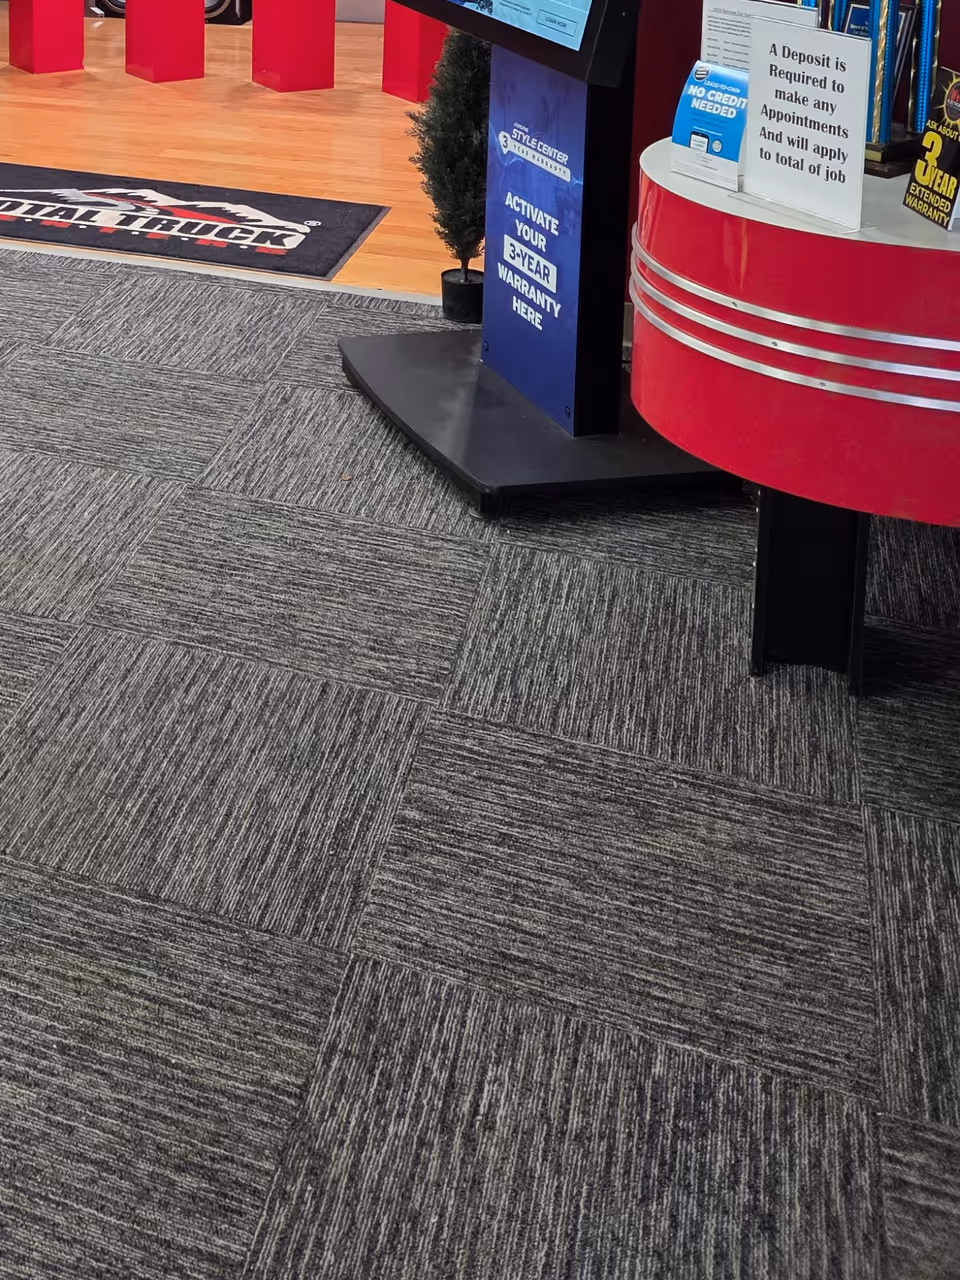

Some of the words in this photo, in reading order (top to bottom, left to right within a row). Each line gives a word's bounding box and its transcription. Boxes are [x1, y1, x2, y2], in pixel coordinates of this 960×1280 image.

[769, 43, 778, 57] A
[782, 45, 831, 70] Deposit
[835, 57, 847, 72] is
[688, 84, 705, 98] NO
[707, 90, 748, 109] CREDIT
[769, 64, 827, 91] Required
[832, 79, 845, 94] to
[691, 98, 737, 119] NEEDED
[774, 87, 809, 107] make
[813, 99, 837, 116] any
[760, 104, 849, 139] Appointments
[926, 119, 938, 132] ASK
[938, 123, 959, 141] ABOUT
[502, 134, 509, 149] 3
[512, 128, 537, 149] STYLE
[537, 141, 569, 166] CENTER
[759, 126, 783, 145] And
[786, 132, 809, 152] will
[813, 141, 849, 165] apply
[915, 131, 942, 186] 3
[759, 147, 772, 161] to
[775, 151, 804, 171] total
[808, 162, 823, 177] of
[824, 166, 846, 184] job
[927, 165, 958, 200] YEAR
[505, 191, 559, 236] ACTIVATE
[905, 193, 950, 228] WARRANTY
[910, 182, 951, 213] EXTENDED
[108, 211, 306, 248] TRUCK
[515, 219, 547, 252] YOUR
[509, 242, 551, 285] 3-YEAR
[497, 262, 561, 318] WARRANTY
[512, 296, 543, 331] HERE
